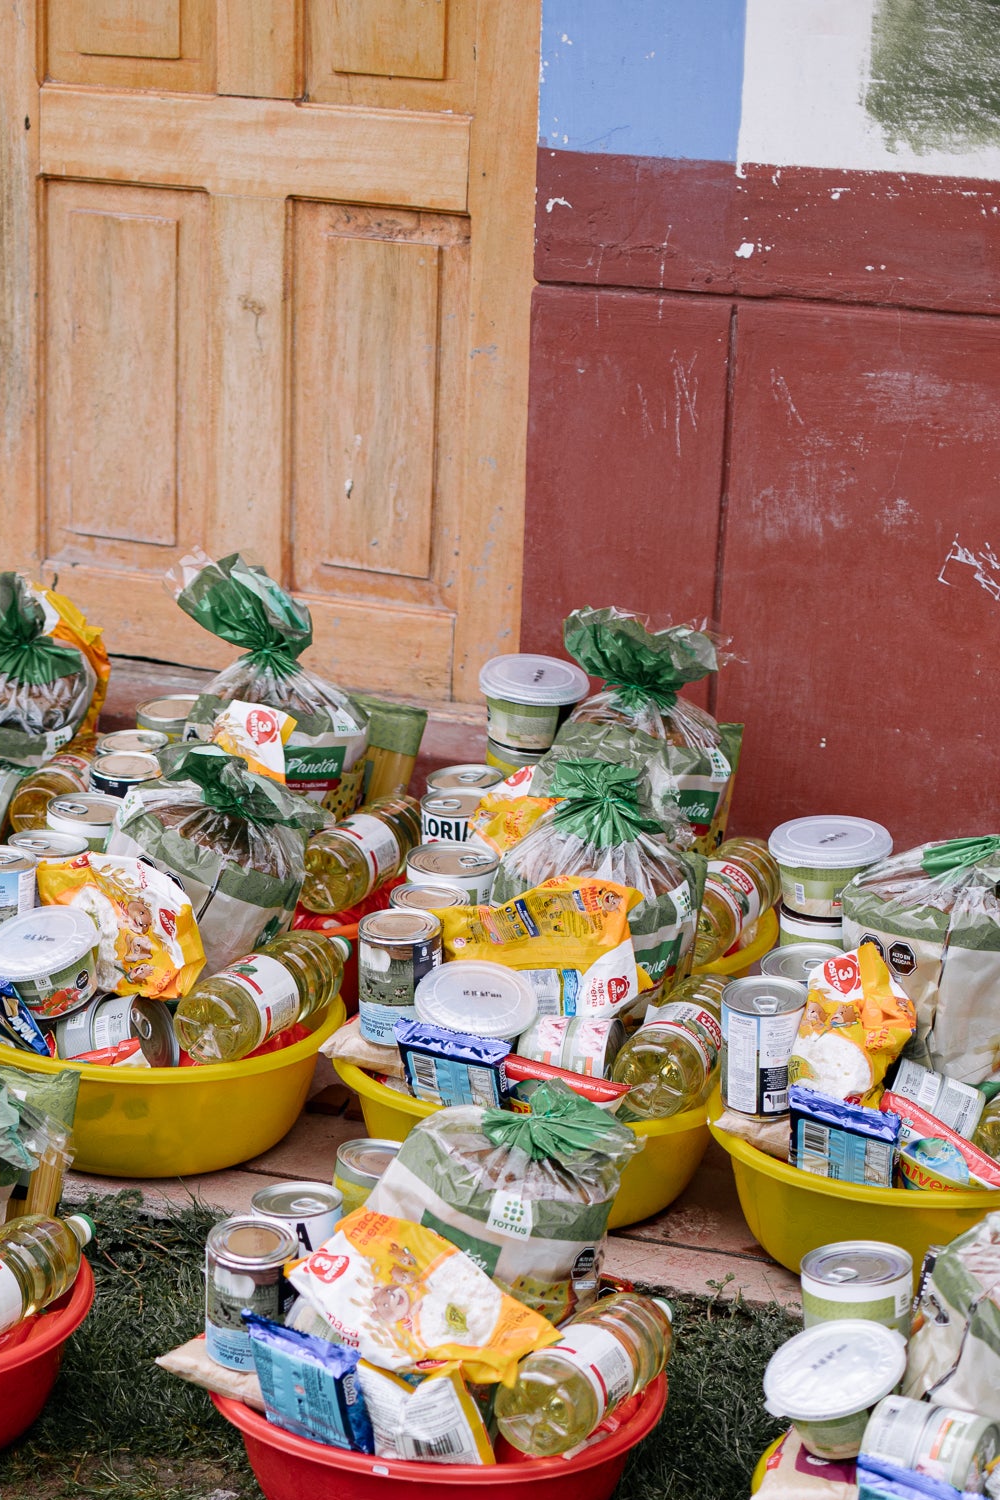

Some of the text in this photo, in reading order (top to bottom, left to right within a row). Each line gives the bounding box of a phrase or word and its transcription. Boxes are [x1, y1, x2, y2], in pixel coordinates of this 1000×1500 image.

[258, 720, 271, 733] 3
[286, 756, 339, 775] Panetón
[892, 951, 911, 961] ALTO EN
[838, 966, 854, 981] 3
[616, 984, 627, 996] 3
[376, 1029, 385, 1038] 78
[492, 1218, 528, 1236] TOTTUS
[315, 1254, 350, 1281] 3 OSITOS
[234, 1355, 245, 1365] 78
